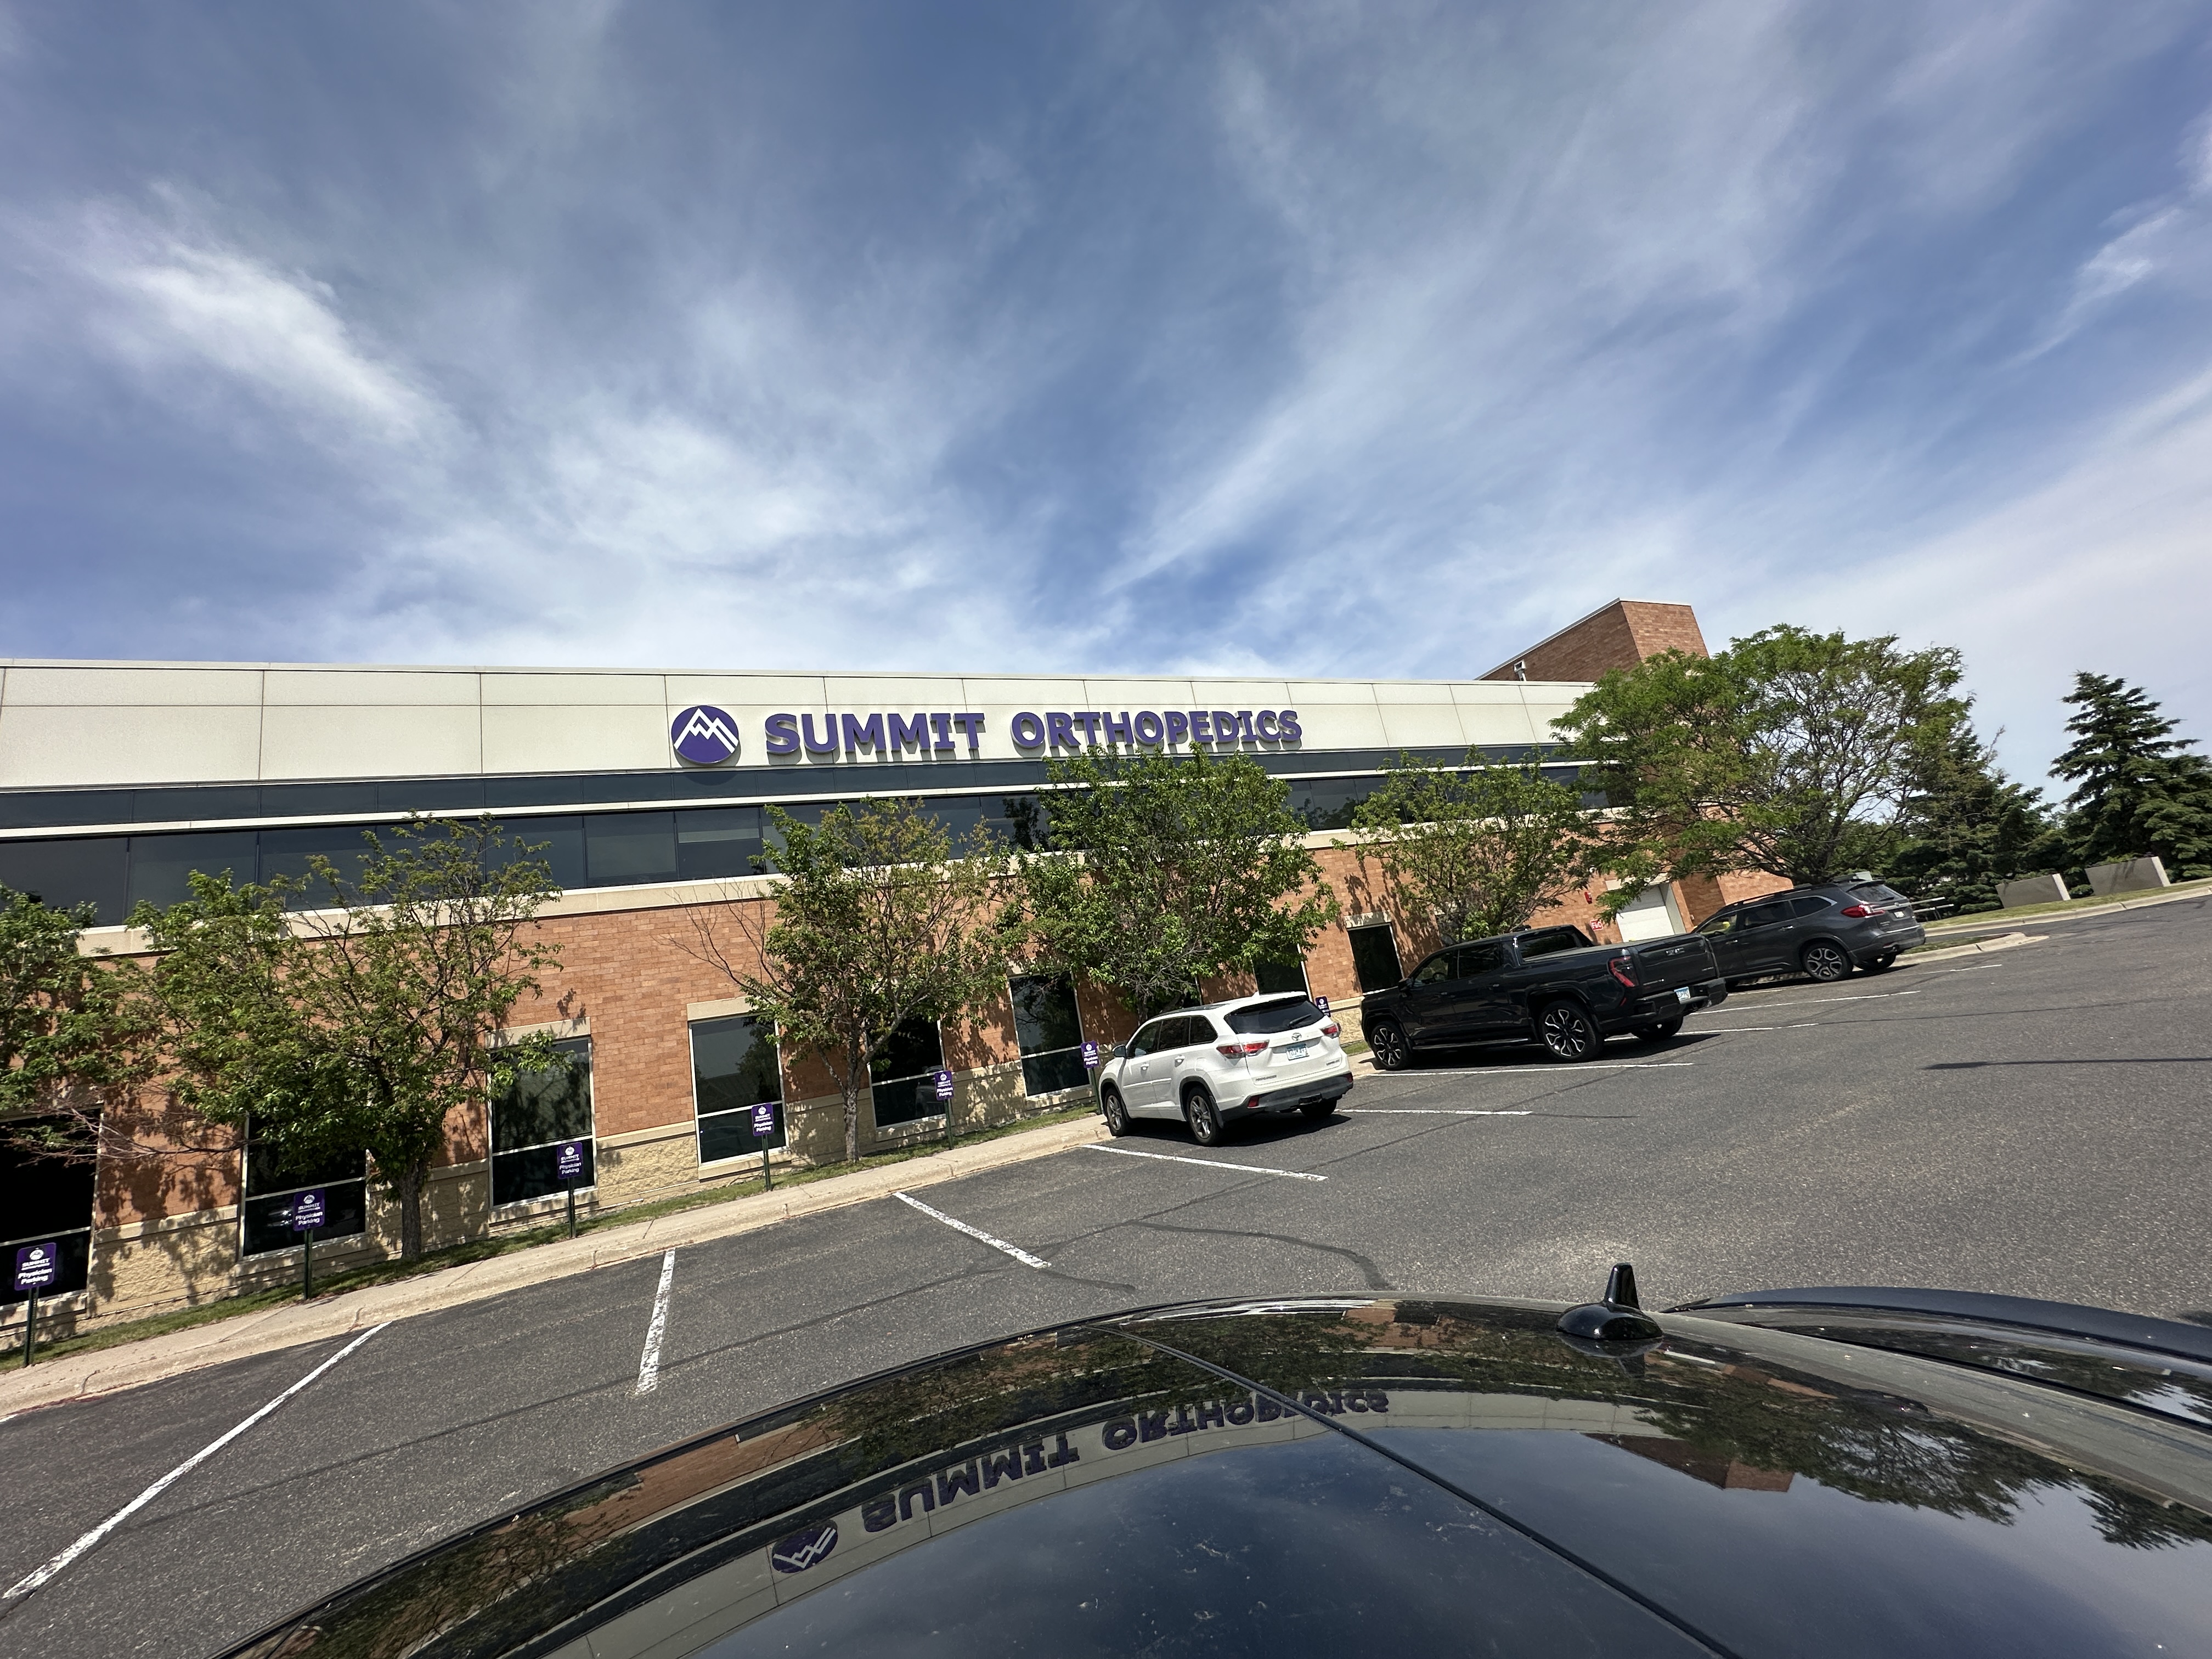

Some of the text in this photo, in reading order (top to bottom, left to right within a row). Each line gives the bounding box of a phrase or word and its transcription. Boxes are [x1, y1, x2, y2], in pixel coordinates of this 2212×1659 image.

[765, 710, 1302, 754] SUMMIT ORTHOPEDICS
[295, 1211, 323, 1220] Physician
[18, 1268, 52, 1279] Physician
[21, 1275, 48, 1284] Parking
